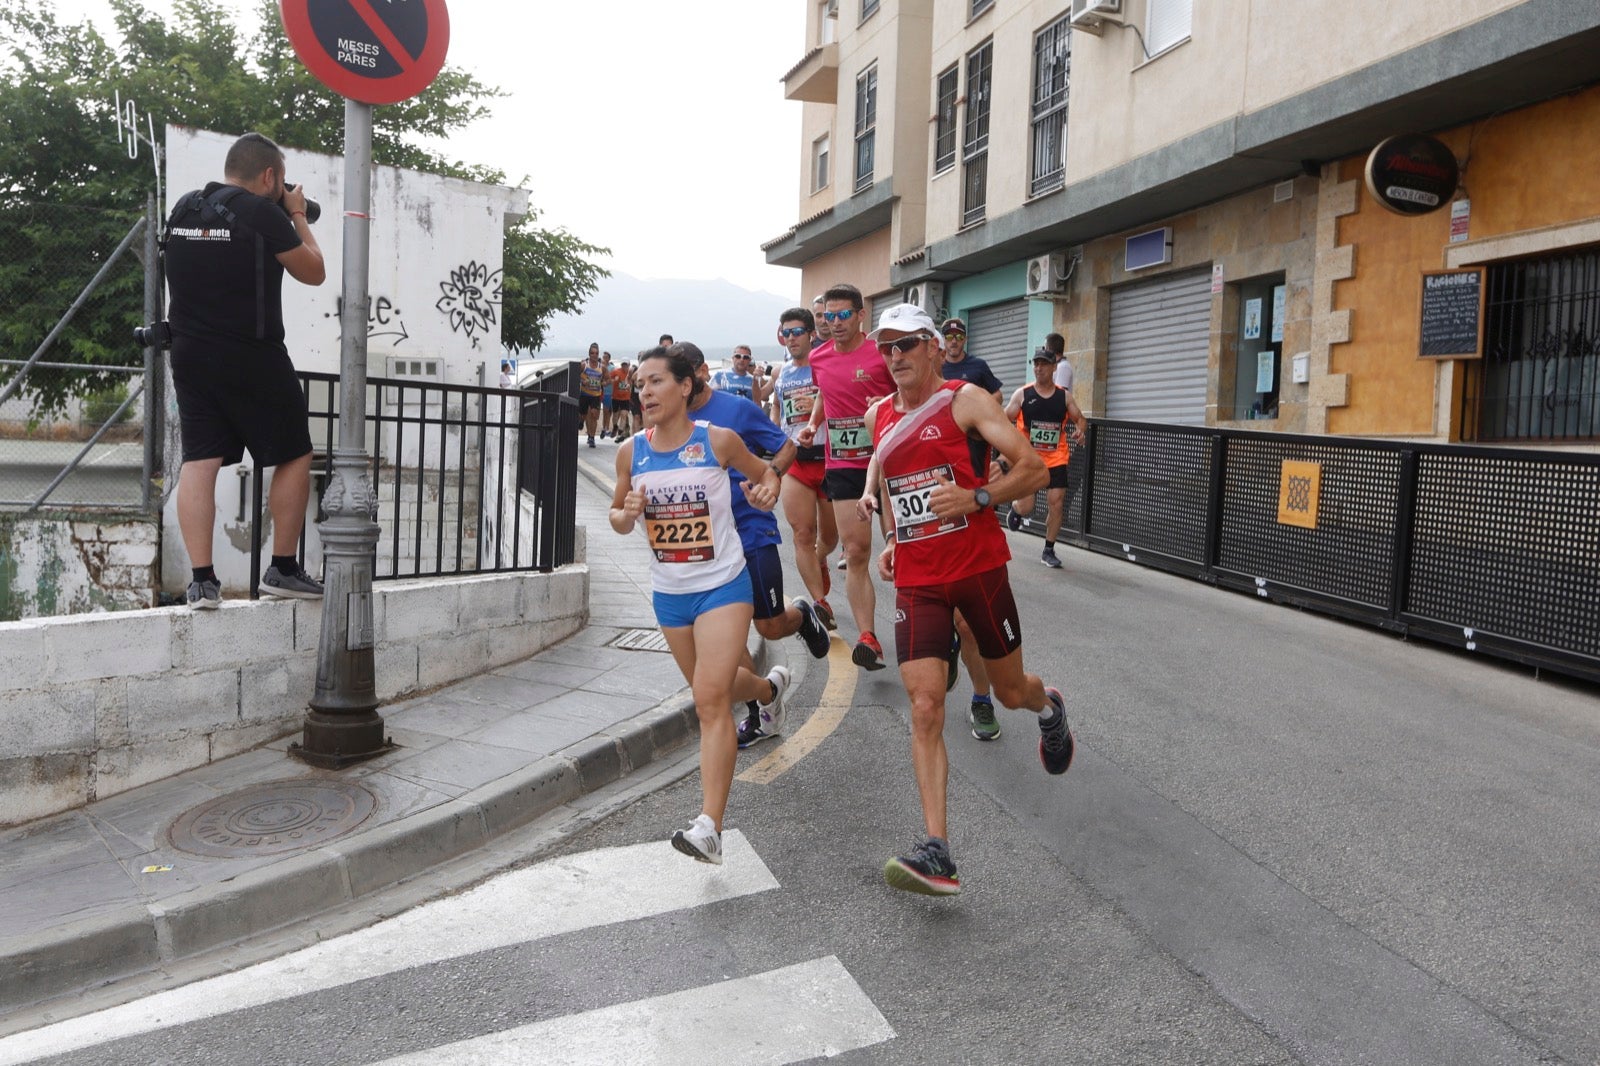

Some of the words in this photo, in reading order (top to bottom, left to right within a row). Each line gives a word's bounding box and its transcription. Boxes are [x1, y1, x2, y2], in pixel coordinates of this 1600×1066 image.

[338, 38, 379, 56] MESES
[338, 51, 376, 68] PARES
[840, 431, 858, 446] 47
[1035, 430, 1057, 441] 457
[658, 484, 707, 494] ATLETISMO
[898, 491, 932, 518] 302
[653, 521, 709, 543] 2222
